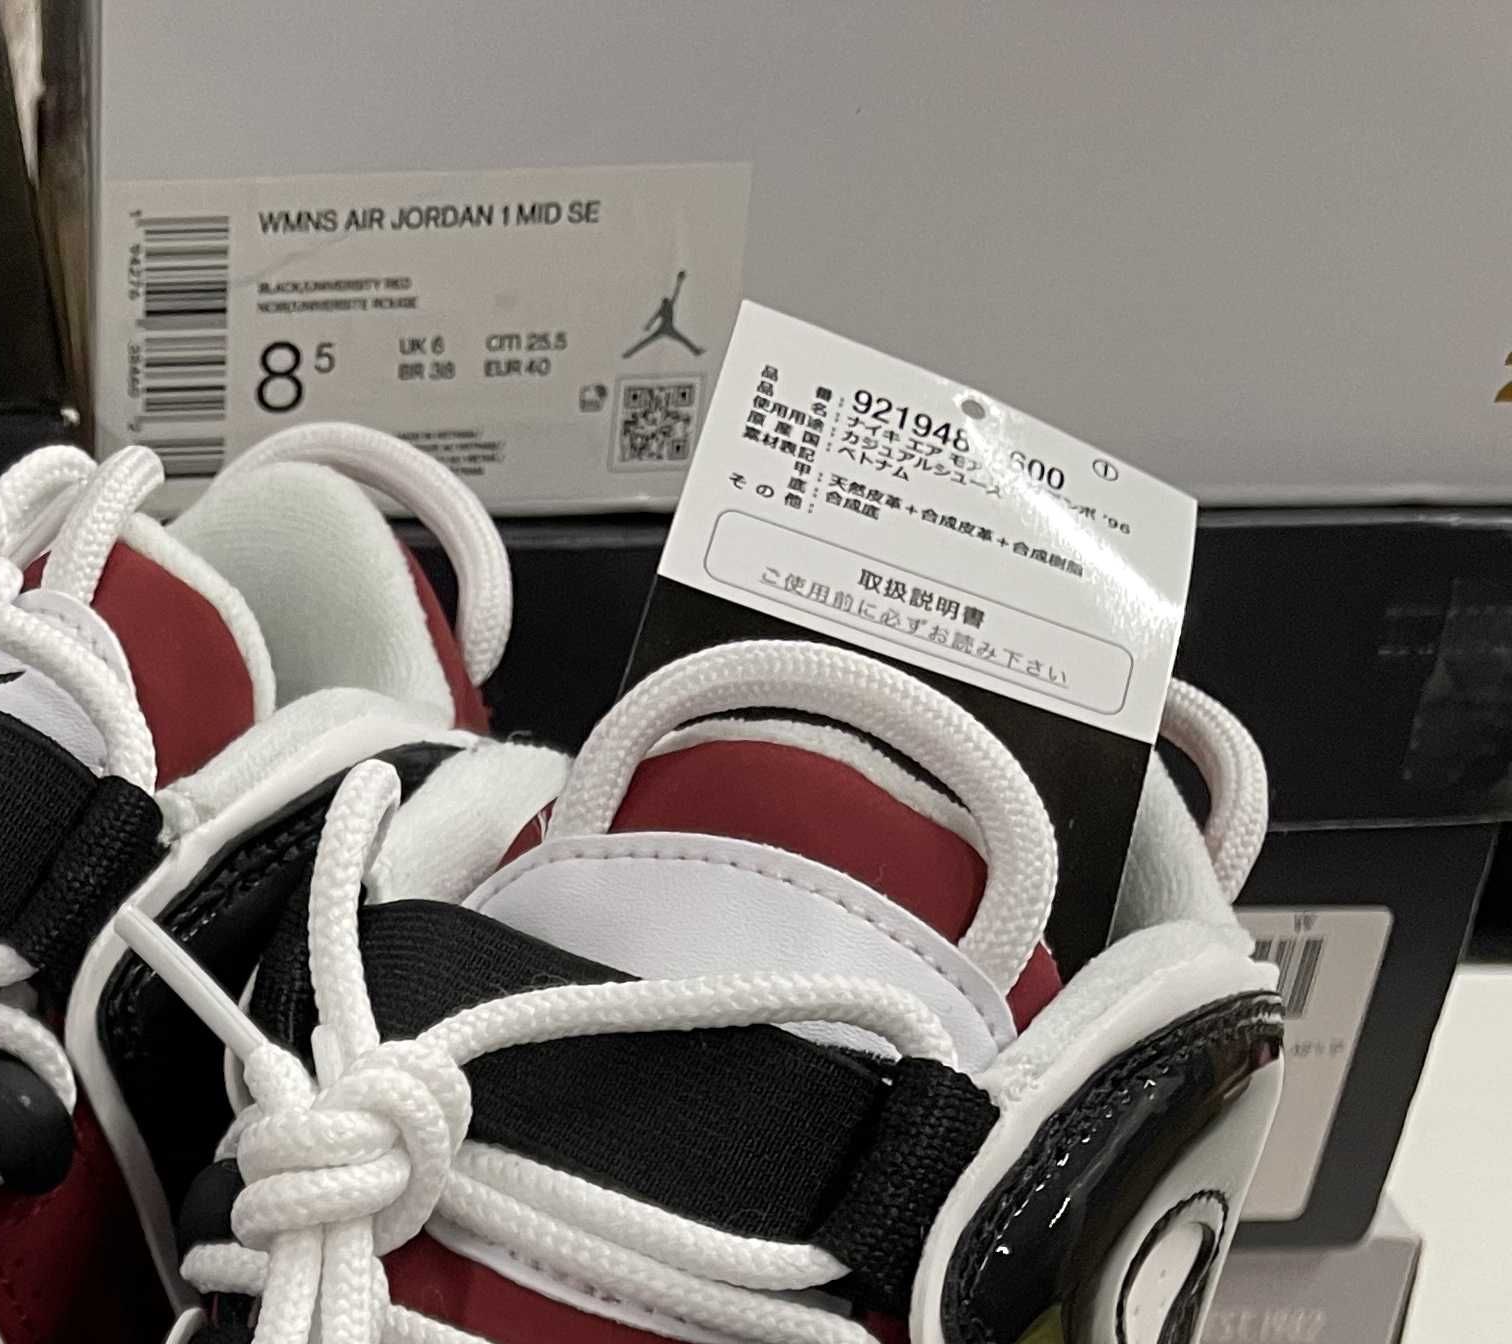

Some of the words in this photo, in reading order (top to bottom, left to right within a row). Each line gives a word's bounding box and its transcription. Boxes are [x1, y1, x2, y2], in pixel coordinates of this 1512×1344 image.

[259, 208, 338, 235] WMNS
[344, 207, 385, 231] AIR
[391, 204, 494, 230] JORDAN
[503, 206, 510, 226] 1
[516, 203, 563, 226] MID
[567, 201, 602, 224] SE
[399, 337, 426, 355] UK
[257, 340, 303, 413] 8
[314, 342, 336, 374] 5
[398, 363, 424, 380] BR
[484, 359, 520, 377] EUR
[838, 446, 910, 481] ベトナム
[858, 568, 986, 630] 取扱説明書
